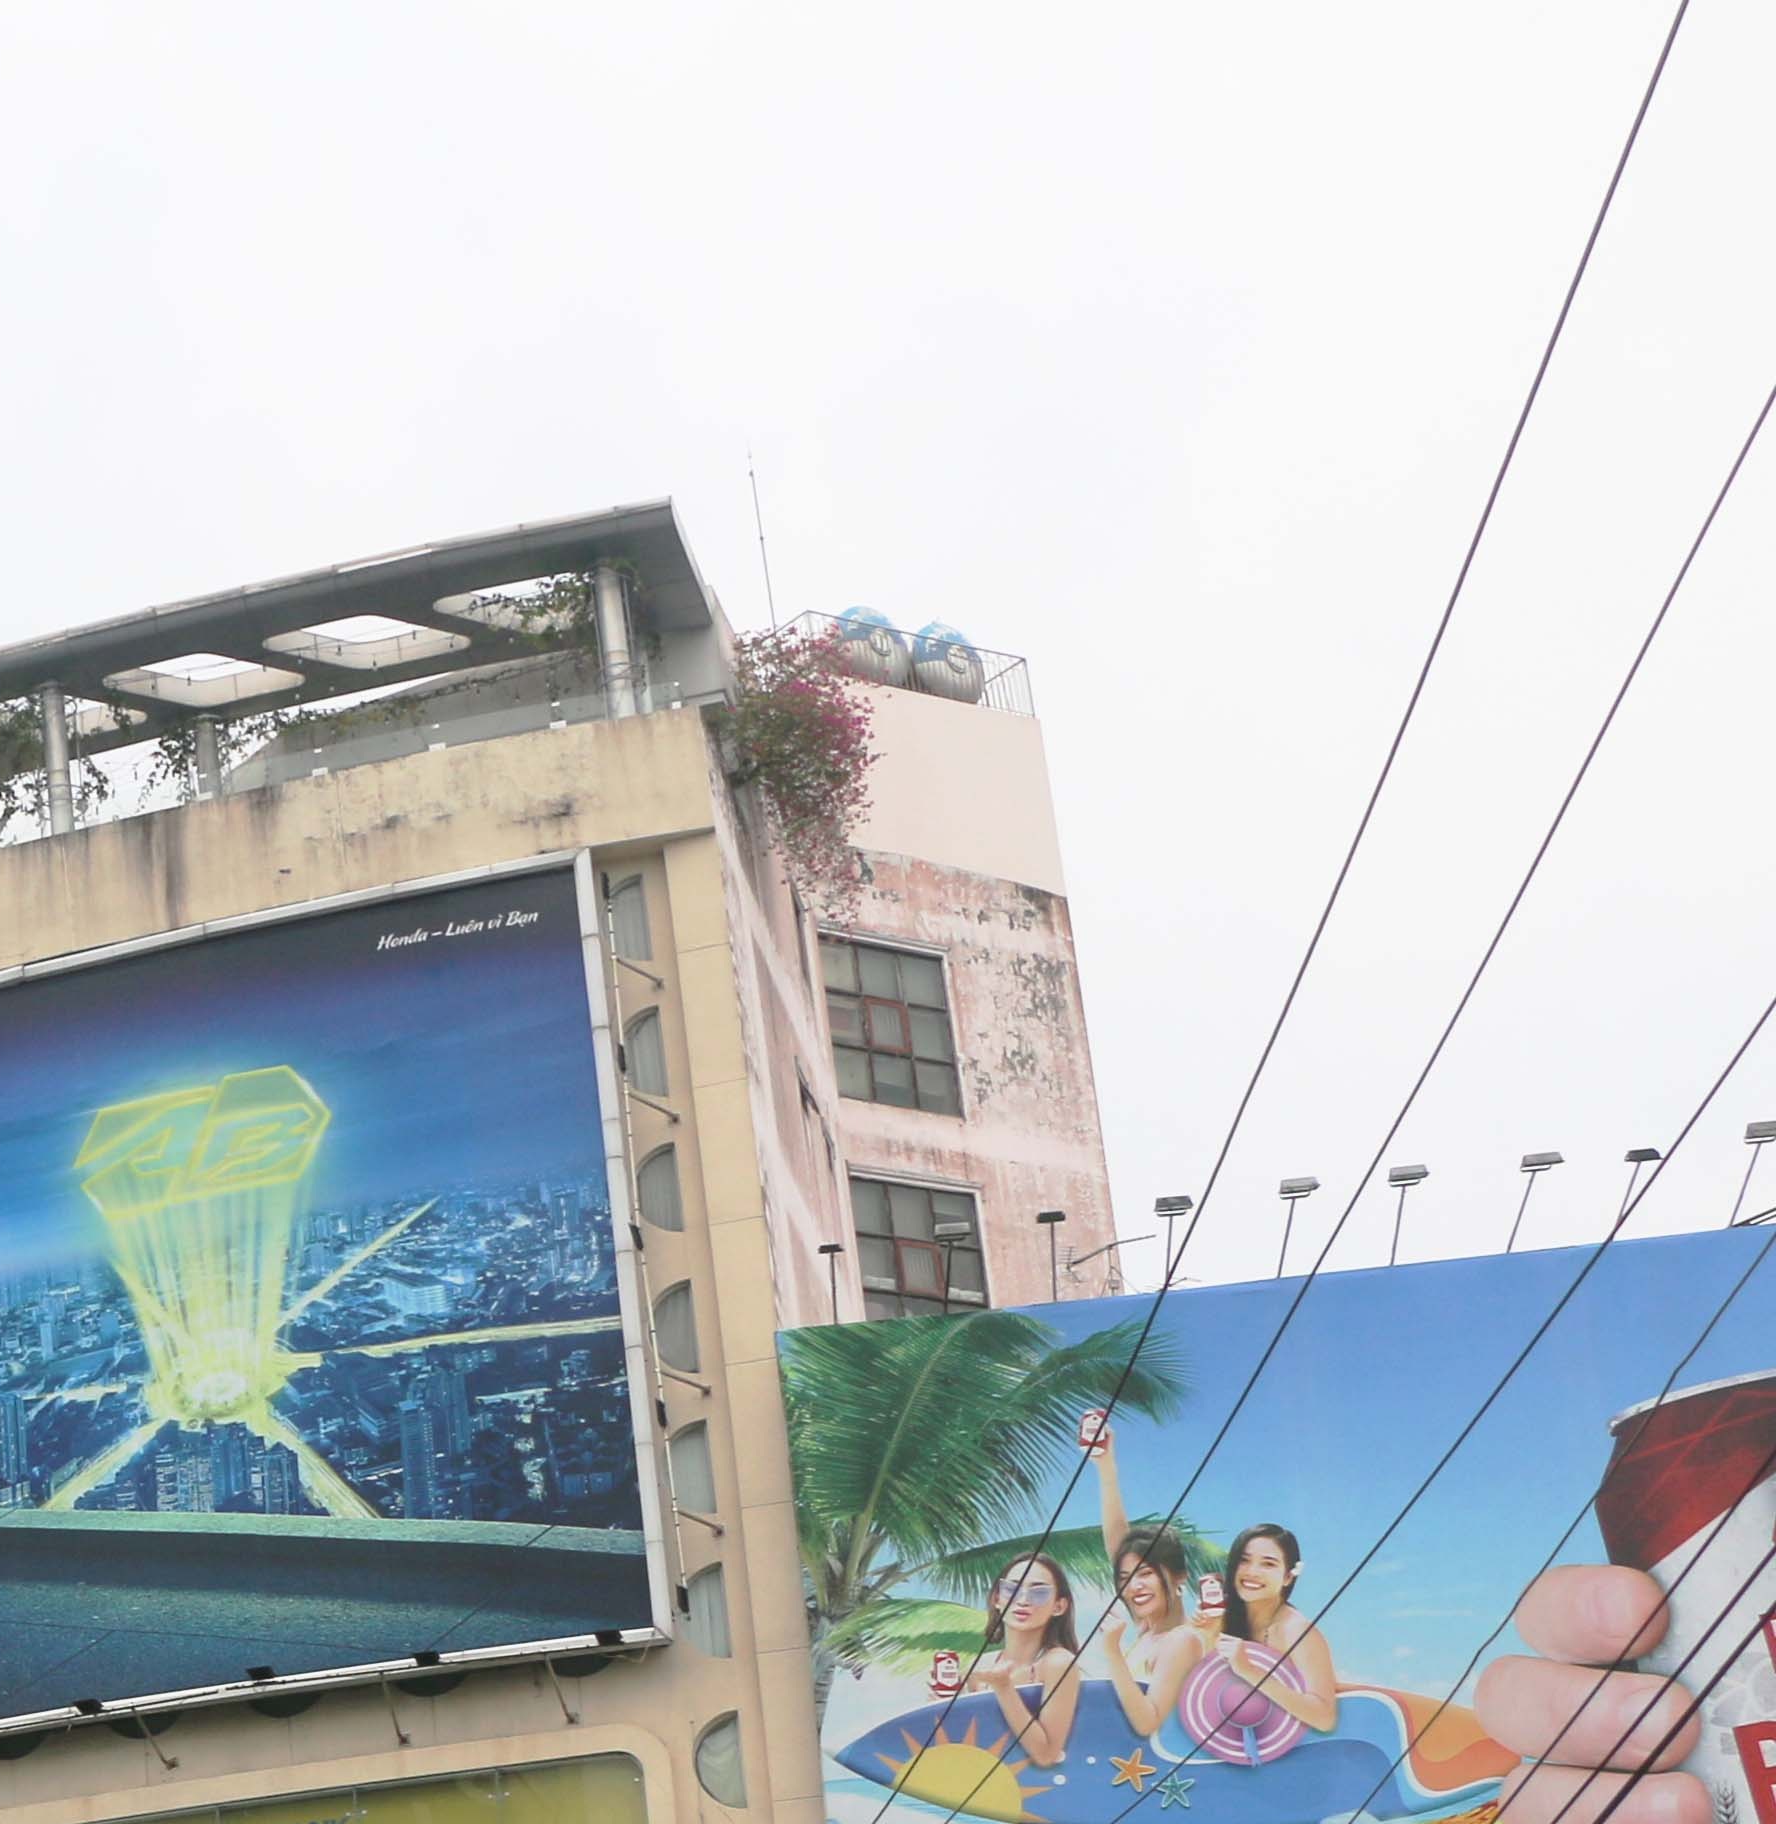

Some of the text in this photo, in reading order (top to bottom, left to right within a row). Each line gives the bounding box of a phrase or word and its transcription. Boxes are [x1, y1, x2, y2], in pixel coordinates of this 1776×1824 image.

[377, 910, 540, 952] Honda Luôn vì Bạn
